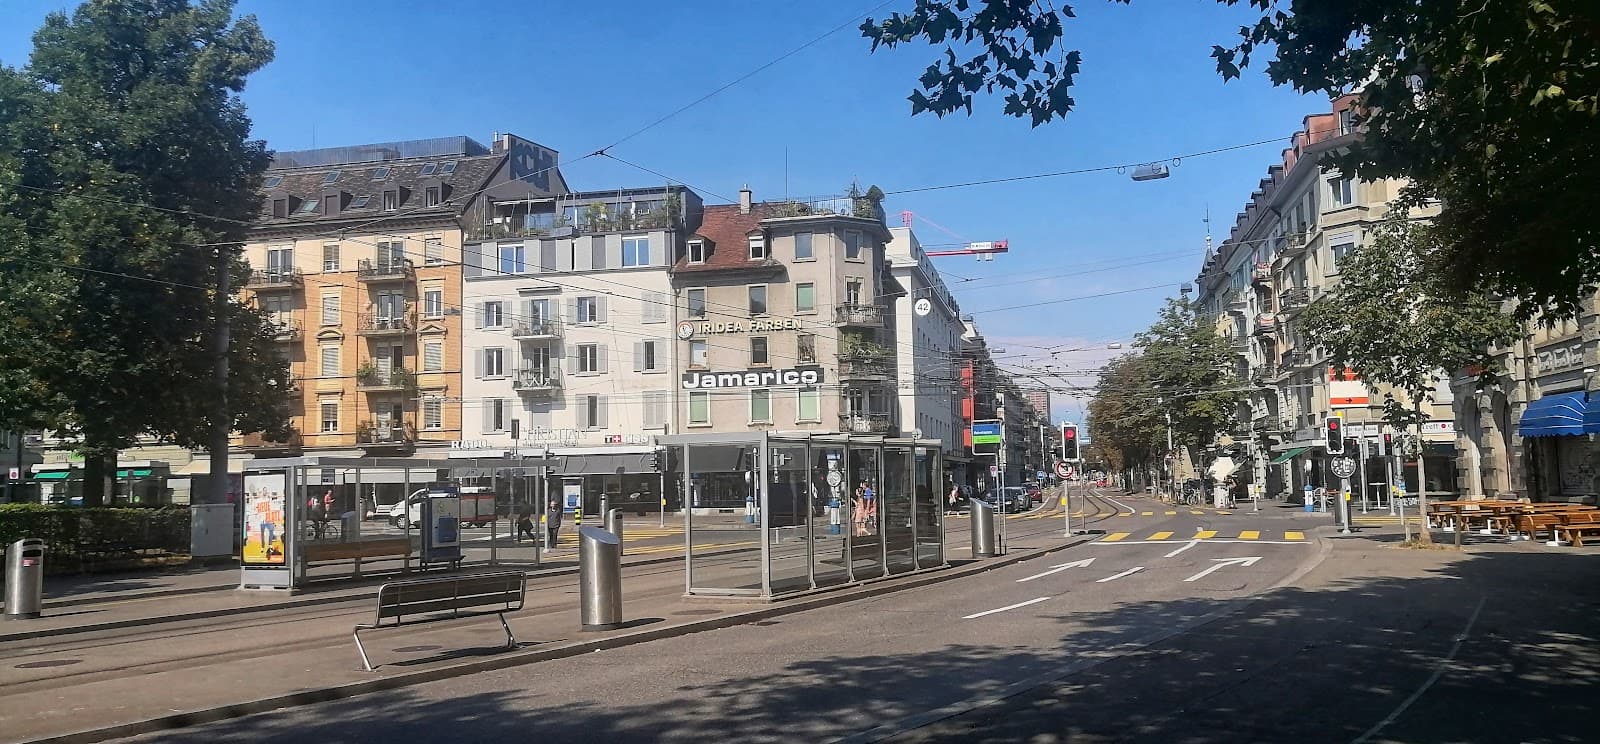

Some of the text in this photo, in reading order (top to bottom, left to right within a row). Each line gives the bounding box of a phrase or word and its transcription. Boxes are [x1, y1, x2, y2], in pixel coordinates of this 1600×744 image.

[917, 302, 929, 311] 42
[698, 318, 802, 334] IRIDEA FARBEN
[683, 369, 818, 388] Jamarico
